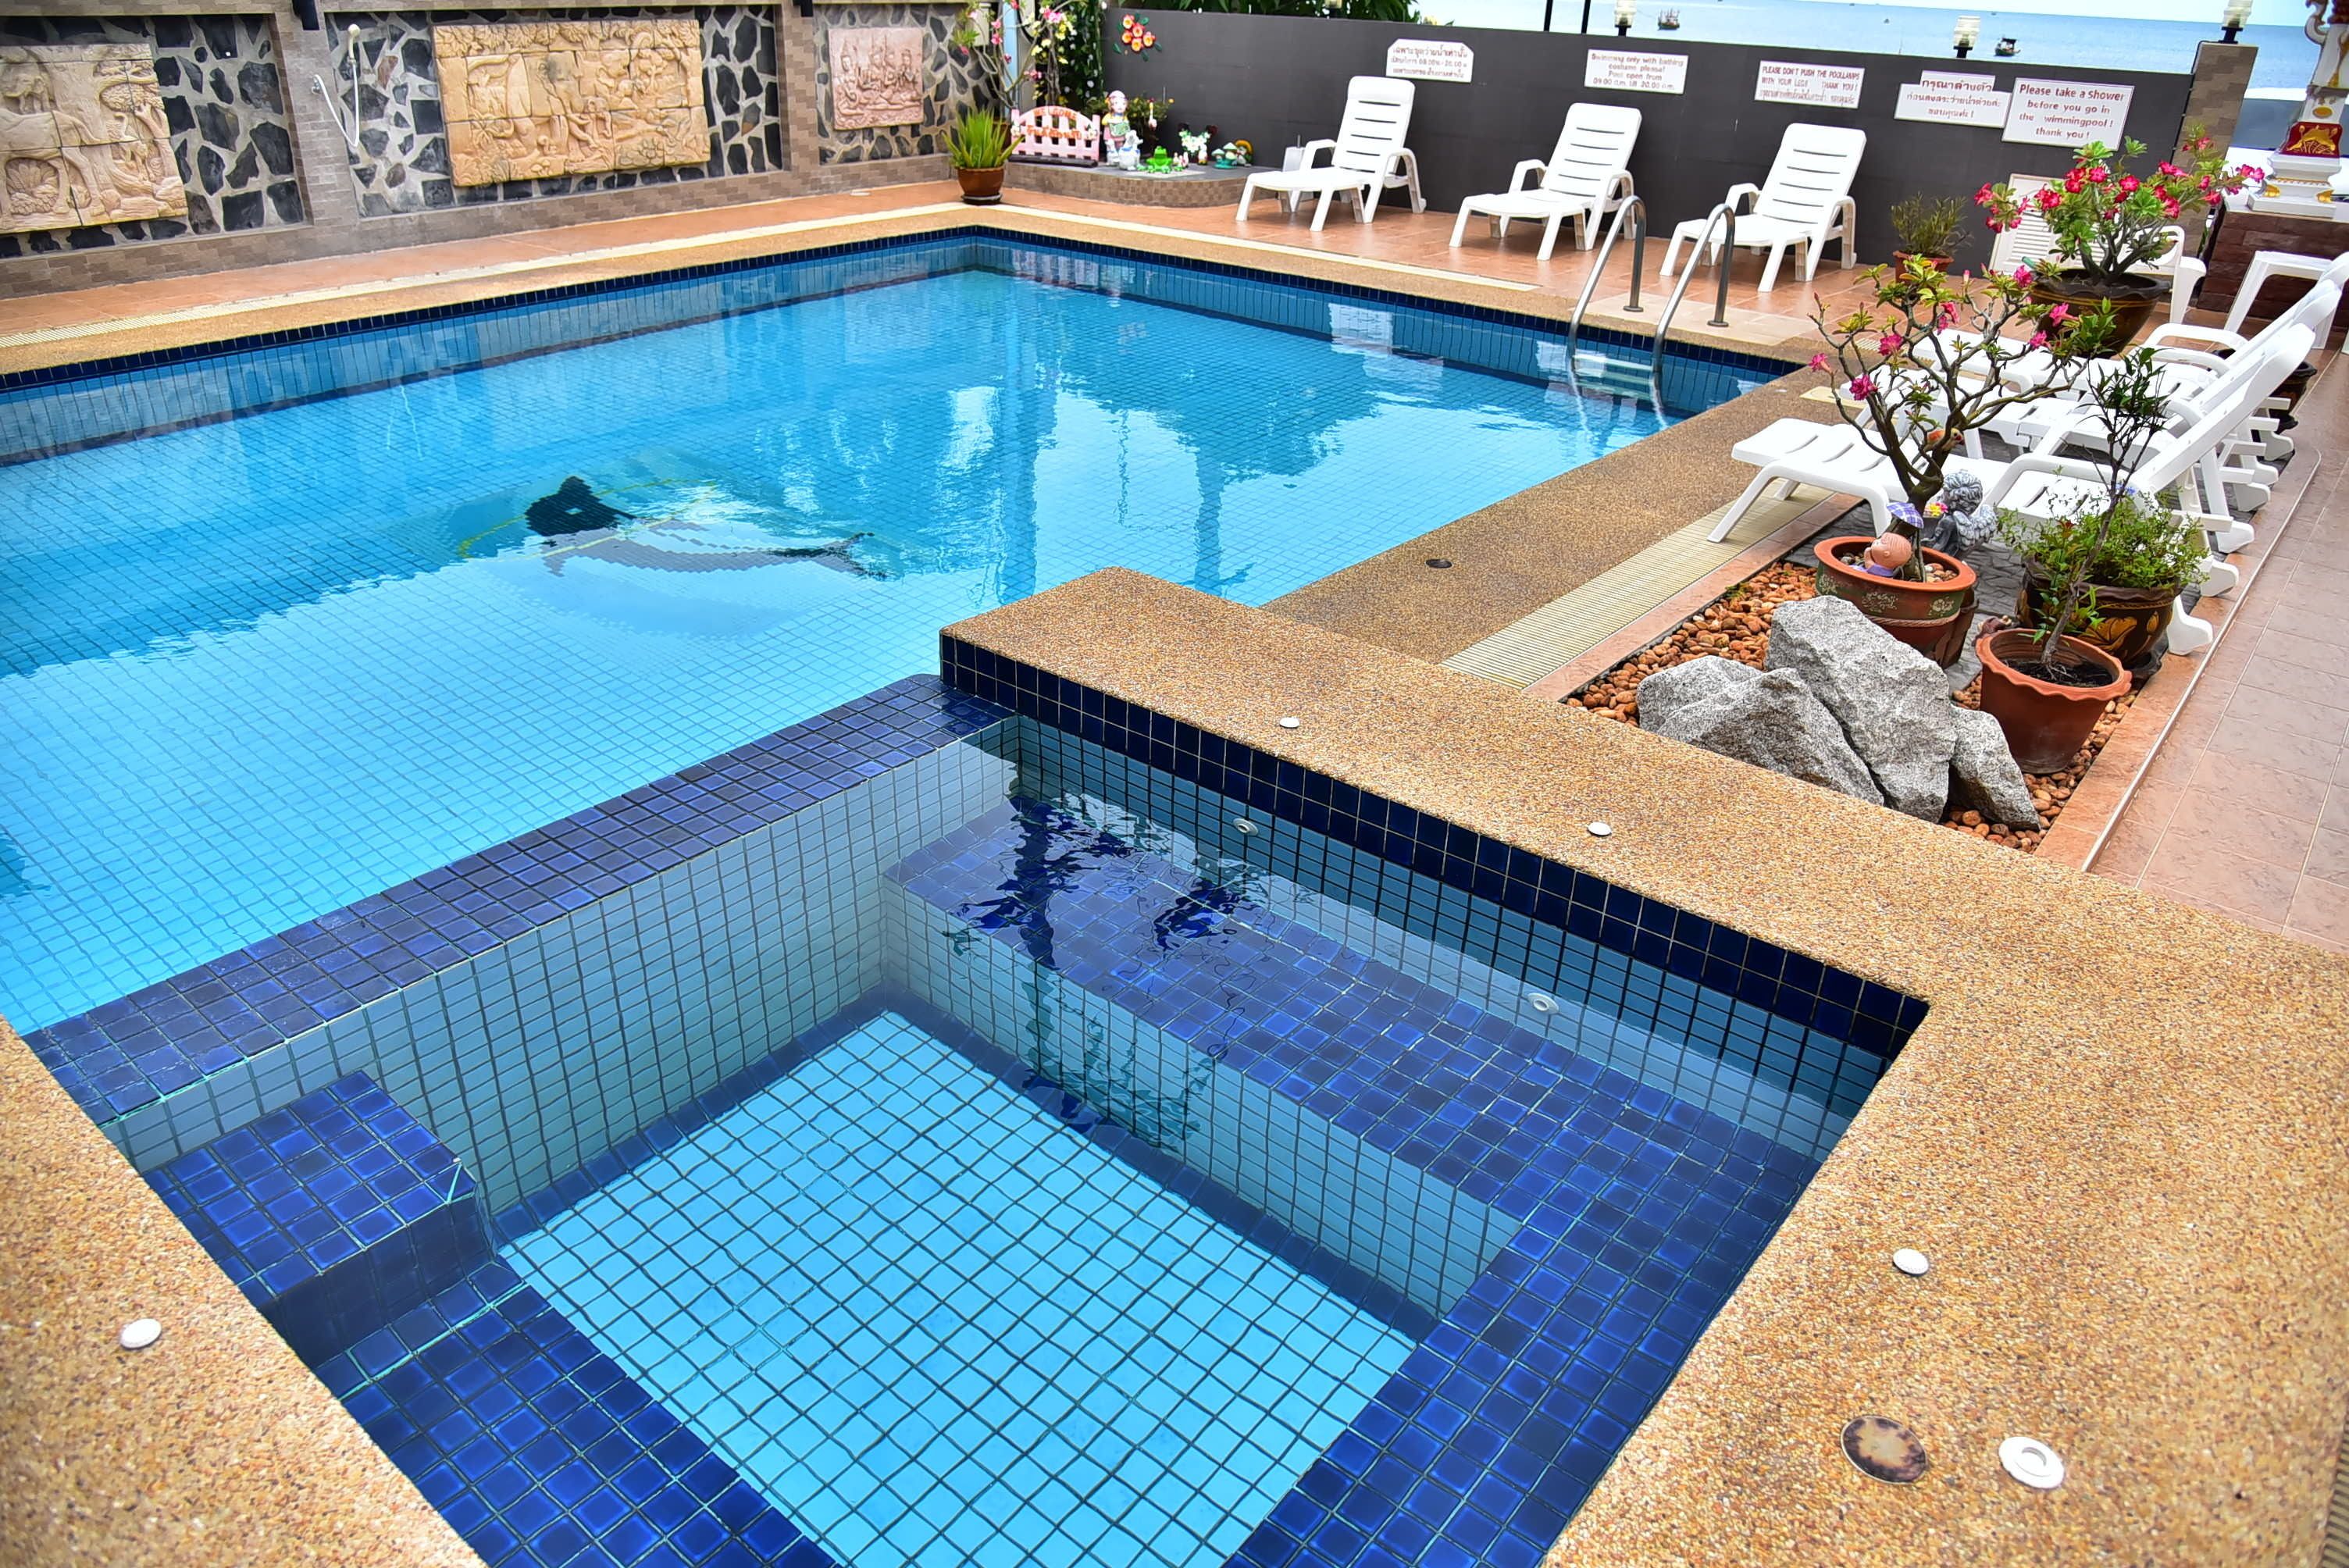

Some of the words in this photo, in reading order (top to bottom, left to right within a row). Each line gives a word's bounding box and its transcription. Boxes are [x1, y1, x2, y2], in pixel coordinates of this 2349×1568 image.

[1626, 56, 1641, 65] only
[1645, 73, 1663, 81] from
[1762, 65, 1781, 75] PLEASE
[1800, 68, 1816, 77] PUSH
[1817, 69, 1827, 78] THE
[1777, 77, 1792, 86] YOUR
[1821, 80, 1839, 90] THANK
[2019, 83, 2051, 95] Please
[2055, 87, 2076, 98] take
[2079, 90, 2086, 98] a
[2027, 99, 2059, 110] before
[2101, 105, 2111, 113] in
[1033, 107, 1078, 120] WELCOME
[2019, 112, 2034, 121] the
[2036, 127, 2062, 137] thank
